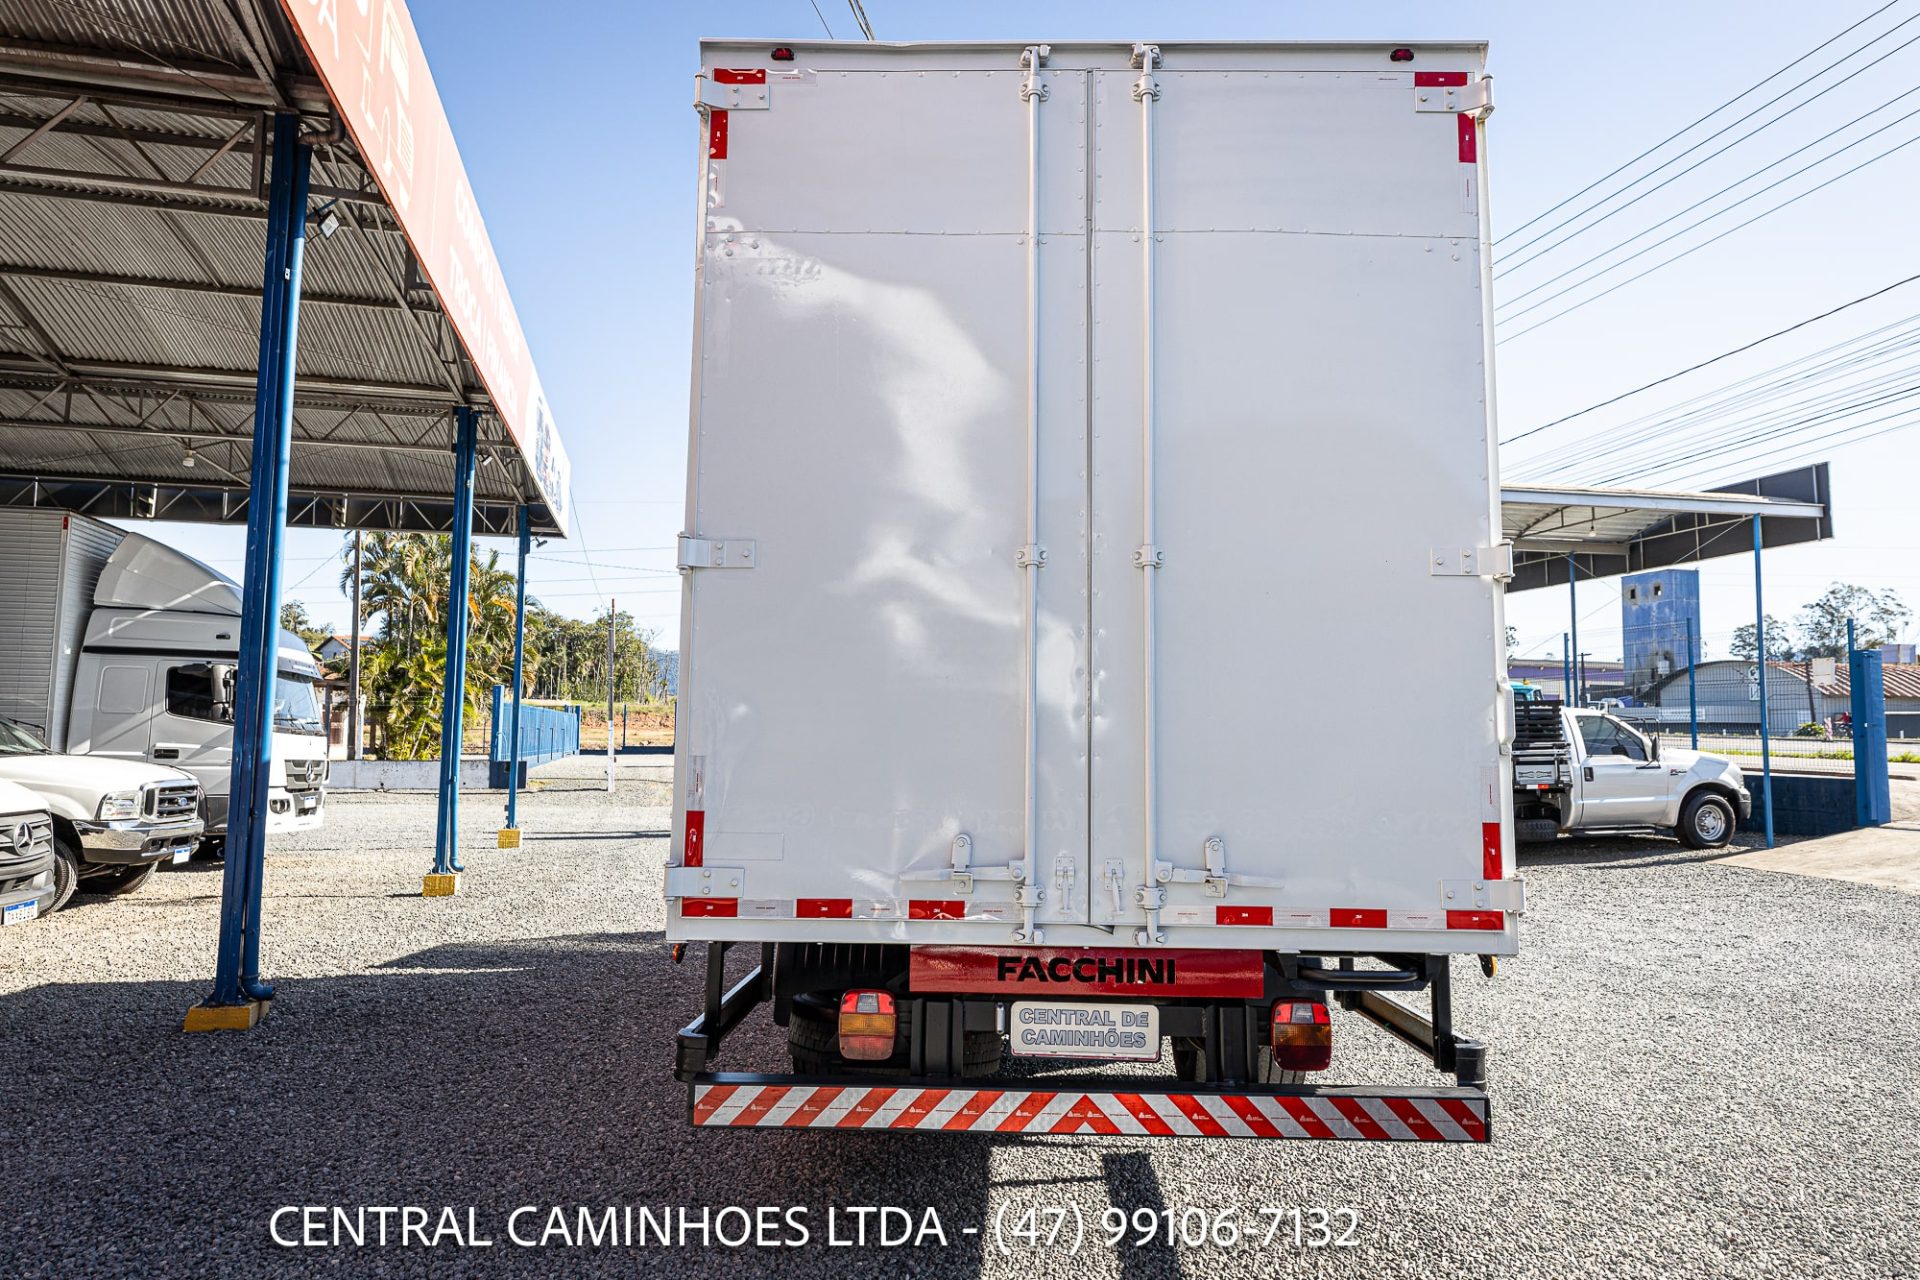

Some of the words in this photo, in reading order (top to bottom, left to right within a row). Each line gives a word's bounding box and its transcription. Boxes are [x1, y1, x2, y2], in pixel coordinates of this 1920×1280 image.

[449, 243, 482, 346] TROCA
[997, 956, 1177, 984] FACCHINI
[1019, 1008, 1117, 1027] CENTRAL
[1121, 1010, 1149, 1028] DE
[1021, 1027, 1147, 1048] CAMINHÕES
